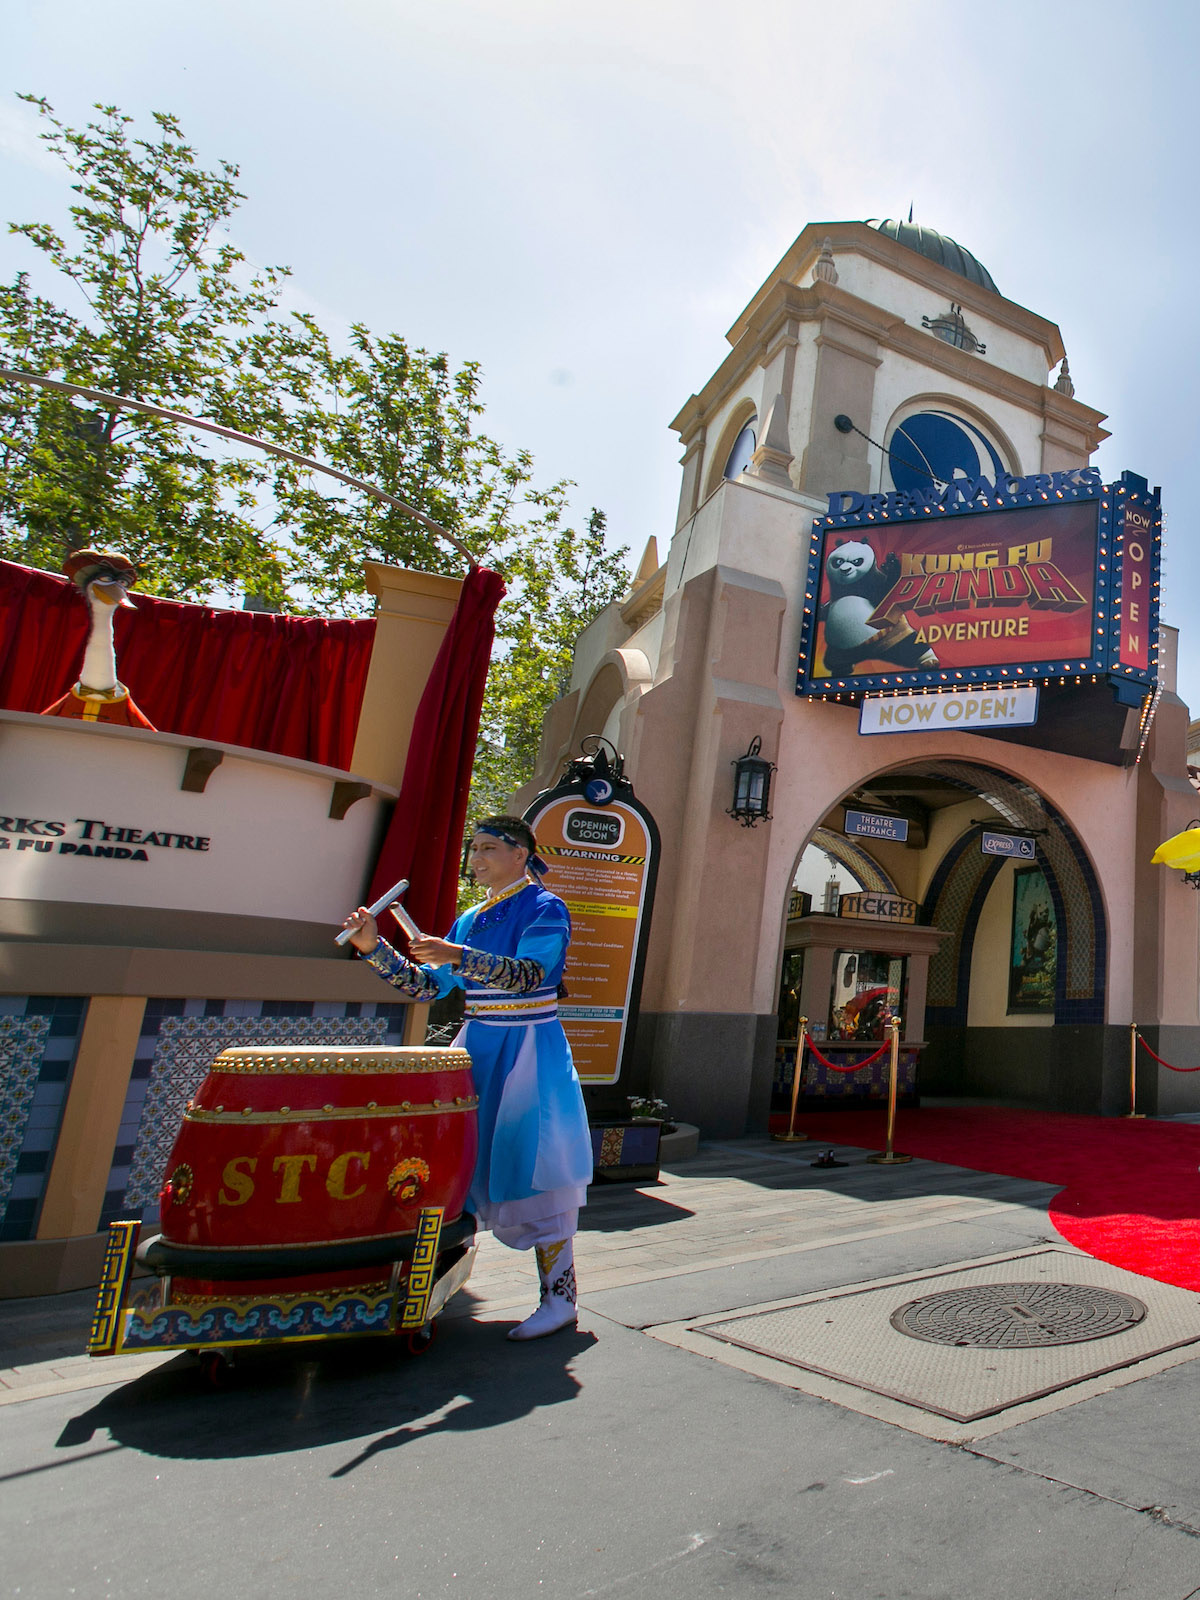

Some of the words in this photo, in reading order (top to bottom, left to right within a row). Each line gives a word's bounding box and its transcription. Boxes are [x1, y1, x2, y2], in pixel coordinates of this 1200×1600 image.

[1126, 510, 1150, 528] NOW
[901, 548, 999, 575] KUNG
[1008, 538, 1053, 566] FU
[865, 561, 1089, 627] PANDA
[1128, 542, 1145, 655] OPEN
[914, 617, 1030, 645] ADVENTURE
[879, 702, 937, 726] NOW
[943, 698, 1016, 721] OPEN!
[571, 819, 617, 834] OPENING
[856, 825, 897, 838] ENTRANCE
[861, 816, 894, 828] THEATRE
[76, 819, 211, 851] THEATRE
[579, 829, 608, 841] SOON
[987, 839, 1012, 851] EXPRESS
[17, 839, 54, 853] FU
[59, 842, 149, 862] PANDA
[560, 848, 620, 862] WARNING
[846, 896, 914, 918] TICKETS
[218, 1151, 371, 1207] STC
